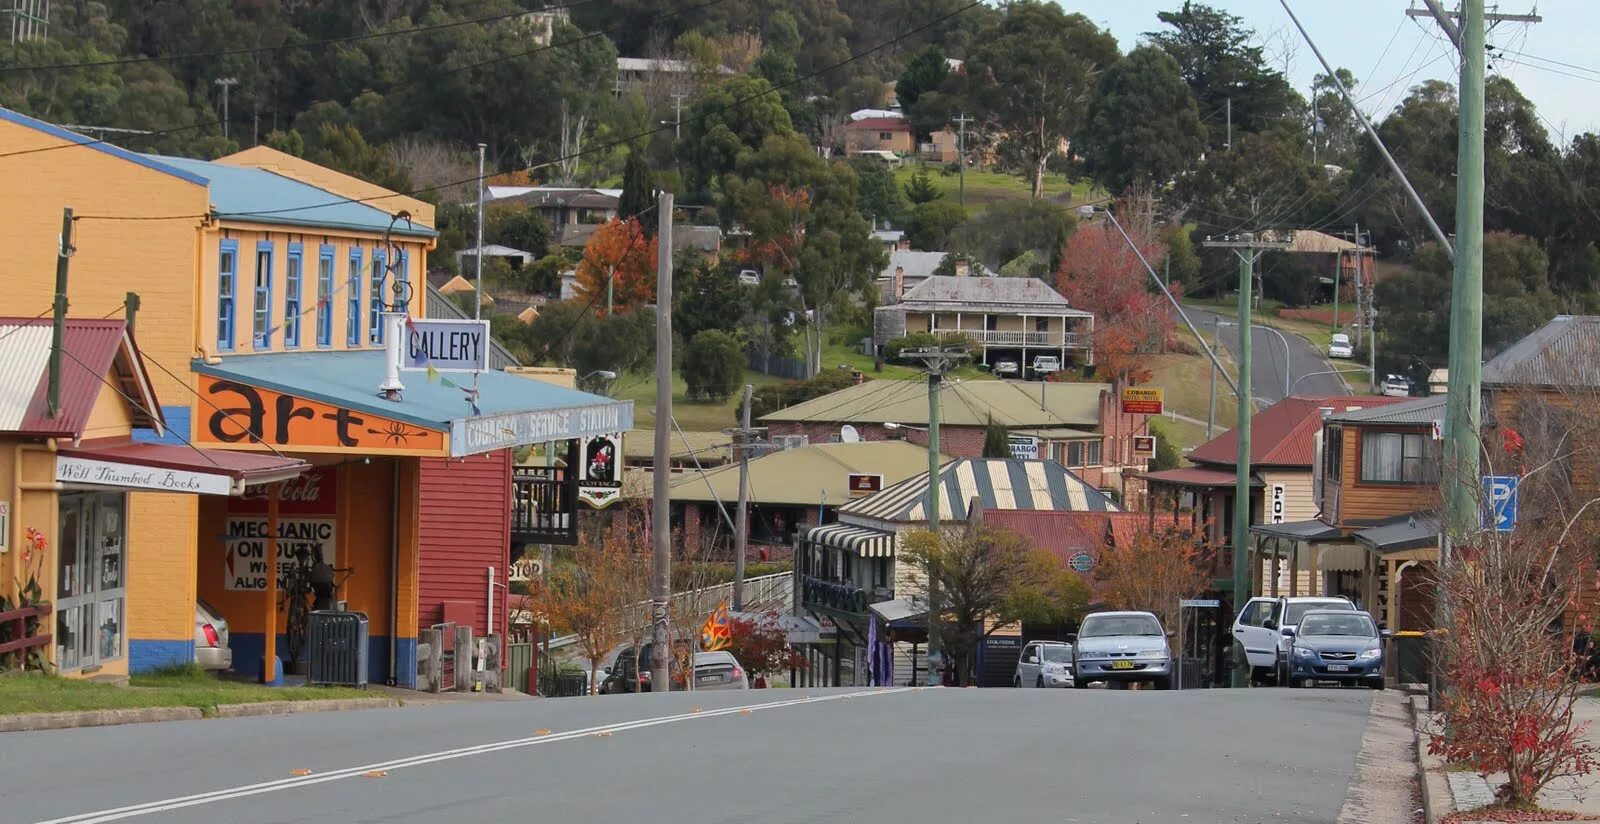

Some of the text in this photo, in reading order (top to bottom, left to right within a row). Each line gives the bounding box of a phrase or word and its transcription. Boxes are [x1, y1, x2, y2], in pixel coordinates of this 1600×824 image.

[209, 380, 364, 447] art
[529, 411, 570, 438] SERVICE
[580, 406, 619, 431] STATION
[59, 463, 200, 490] Well Thumbed Books
[237, 541, 263, 558] ON
